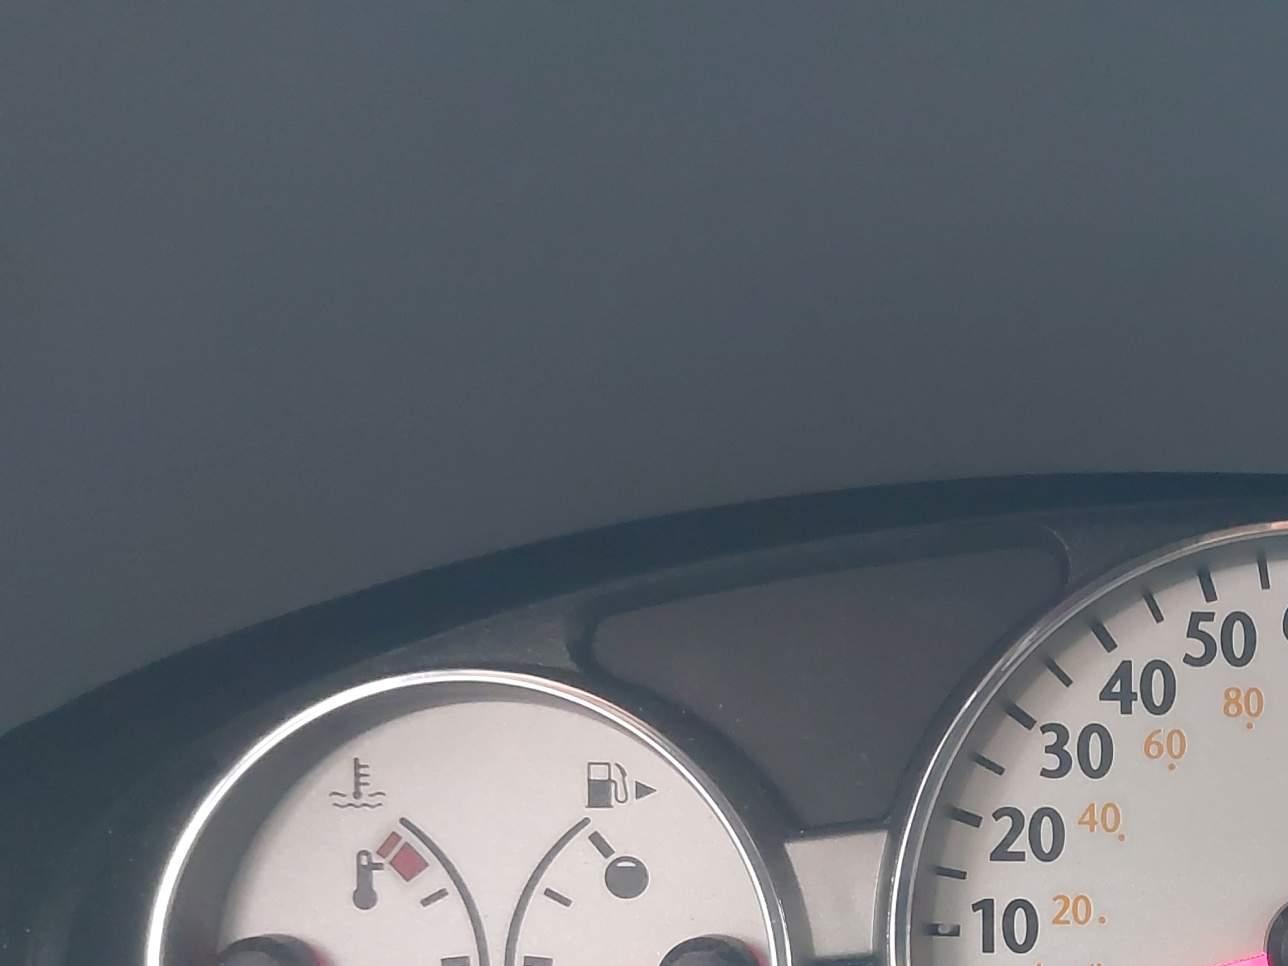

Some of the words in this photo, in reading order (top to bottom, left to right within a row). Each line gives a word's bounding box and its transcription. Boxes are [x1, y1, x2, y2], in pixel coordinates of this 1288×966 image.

[1183, 611, 1257, 667] 50
[1099, 660, 1177, 716] 40
[1222, 686, 1264, 718] 80
[1039, 723, 1114, 779] 30
[1143, 728, 1187, 759] 60
[989, 807, 1066, 862] 20
[1077, 802, 1121, 833] 40
[971, 898, 1039, 955] 10
[1051, 895, 1092, 926] 20
